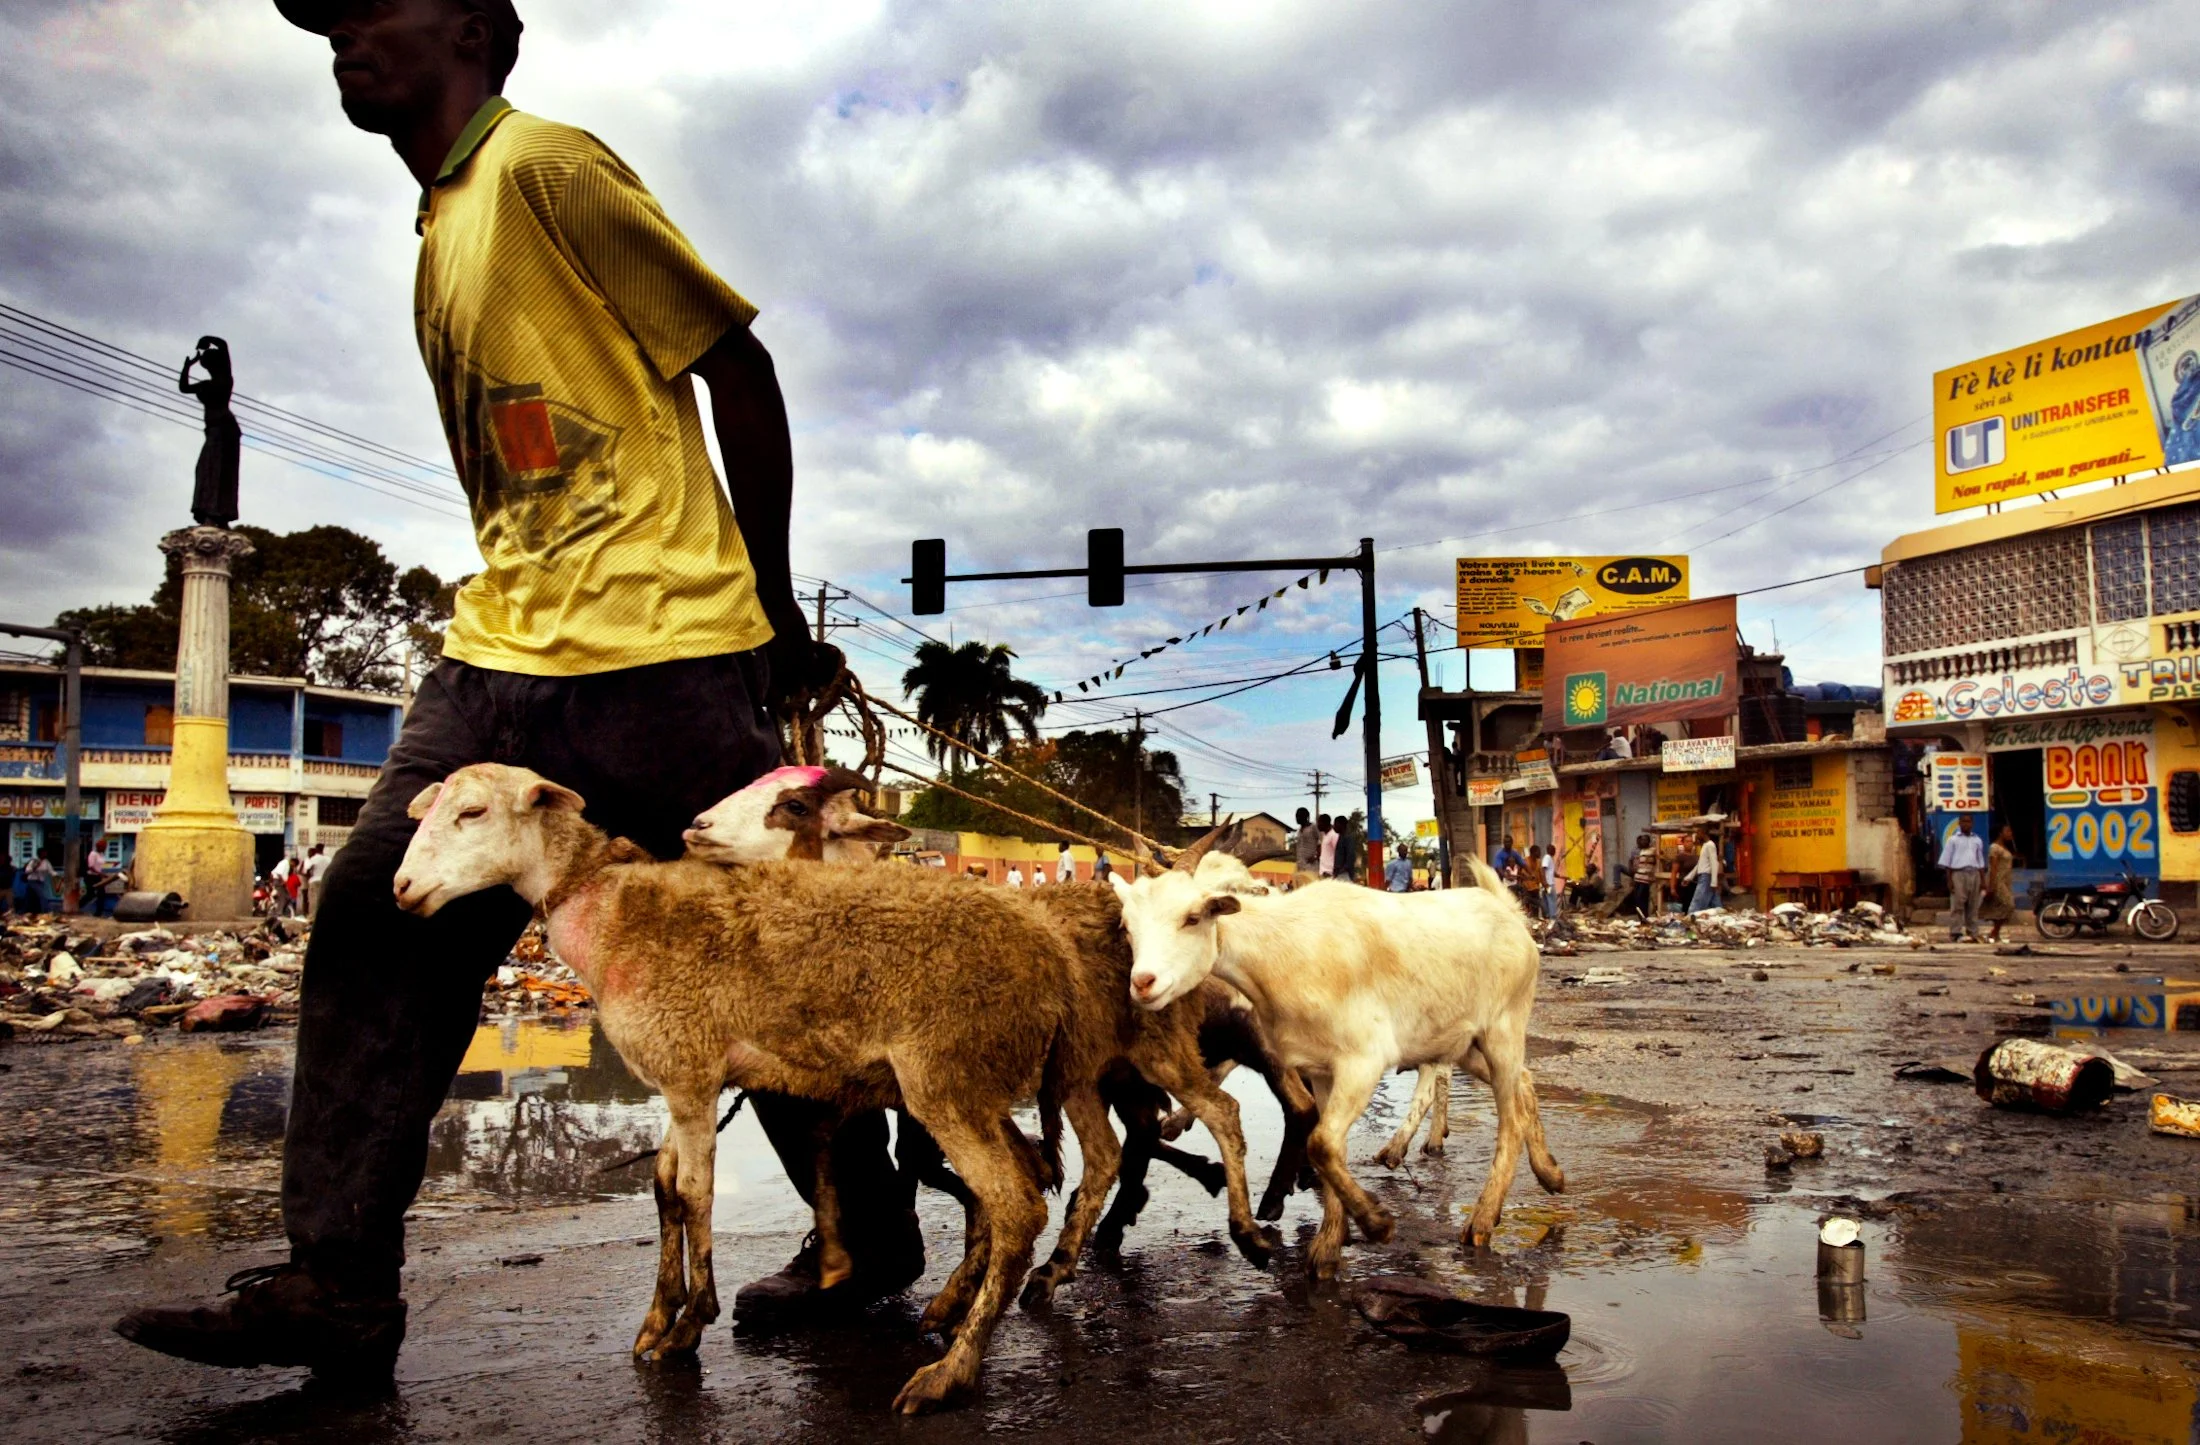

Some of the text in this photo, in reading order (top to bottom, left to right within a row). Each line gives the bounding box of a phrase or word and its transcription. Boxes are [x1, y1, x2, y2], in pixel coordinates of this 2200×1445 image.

[1948, 371, 1980, 401] Fè
[1987, 360, 2016, 390] kè
[2024, 352, 2043, 380] li
[2051, 329, 2152, 373] kontan
[2011, 388, 2130, 431] UNITRANSFER
[1952, 485, 1981, 499] Nou
[1985, 471, 2031, 492] rapid,
[1459, 561, 1489, 569] Votre
[1491, 561, 1527, 569] argent
[1495, 568, 1509, 576] de
[1523, 568, 1562, 576] heures
[1602, 566, 1677, 585] C.A.M.
[1469, 576, 1515, 584] domicile
[2119, 655, 2200, 688] TRI
[1615, 672, 1723, 706] National
[1945, 667, 2112, 719] Celeste
[1687, 738, 1713, 747] AVANT
[2046, 740, 2149, 789] BANK
[244, 796, 278, 808] PARTS
[1942, 799, 1980, 809] TOP
[2048, 809, 2154, 858] 2002
